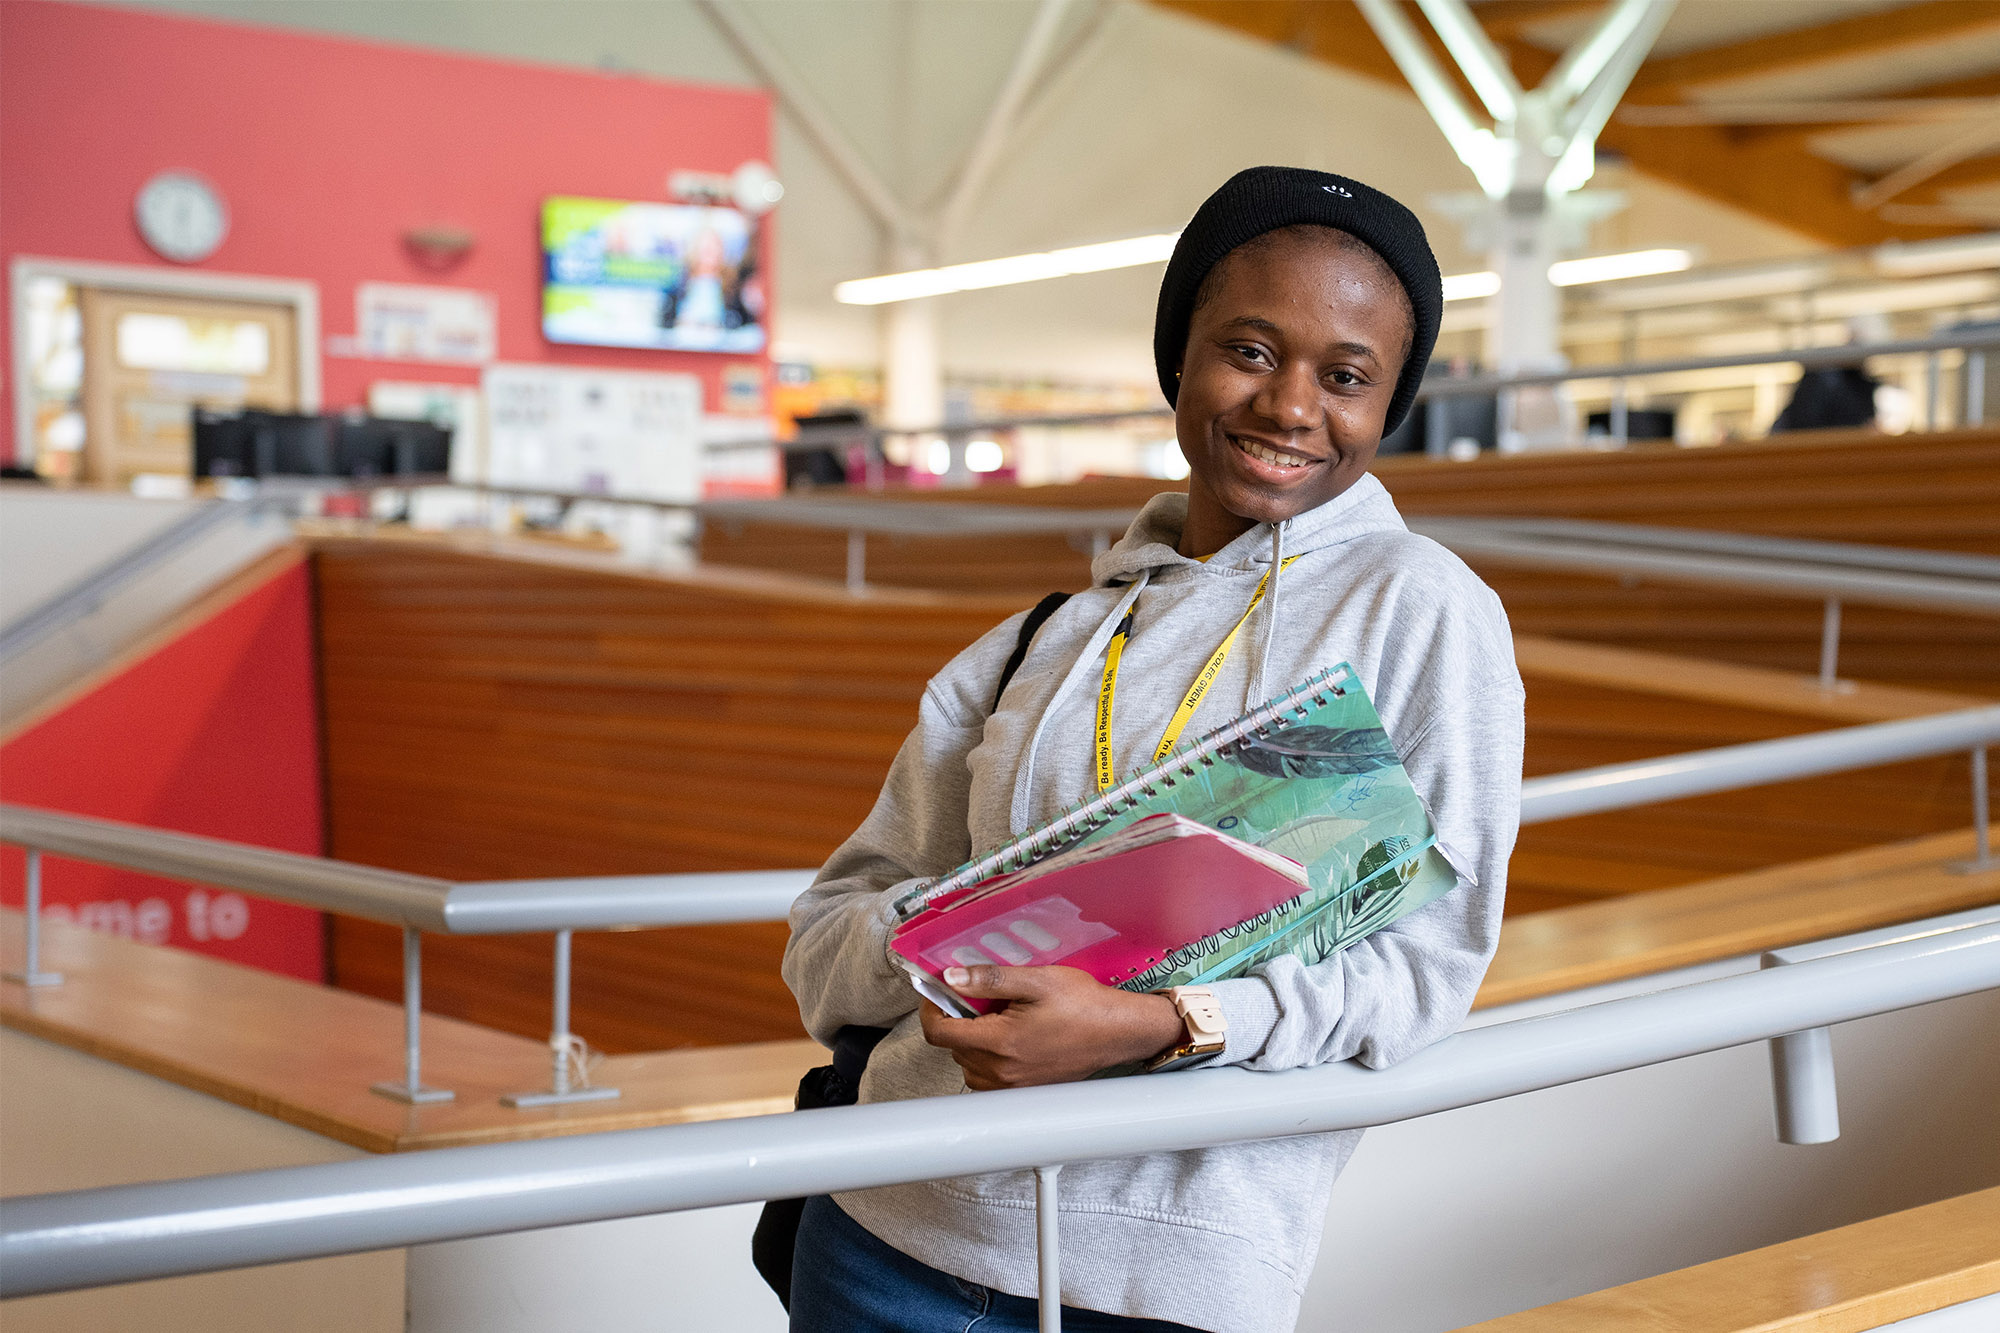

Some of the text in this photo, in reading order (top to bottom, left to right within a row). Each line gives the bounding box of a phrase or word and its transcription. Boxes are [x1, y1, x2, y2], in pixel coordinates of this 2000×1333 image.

[1186, 652, 1225, 709] COLEG GWENT
[1103, 682, 1112, 693] Be
[1099, 731, 1107, 743] Be
[1162, 739, 1174, 750] Yn
[1099, 744, 1109, 770] ready.
[1101, 772, 1109, 784] Be
[1362, 857, 1383, 889] NOTEOK
